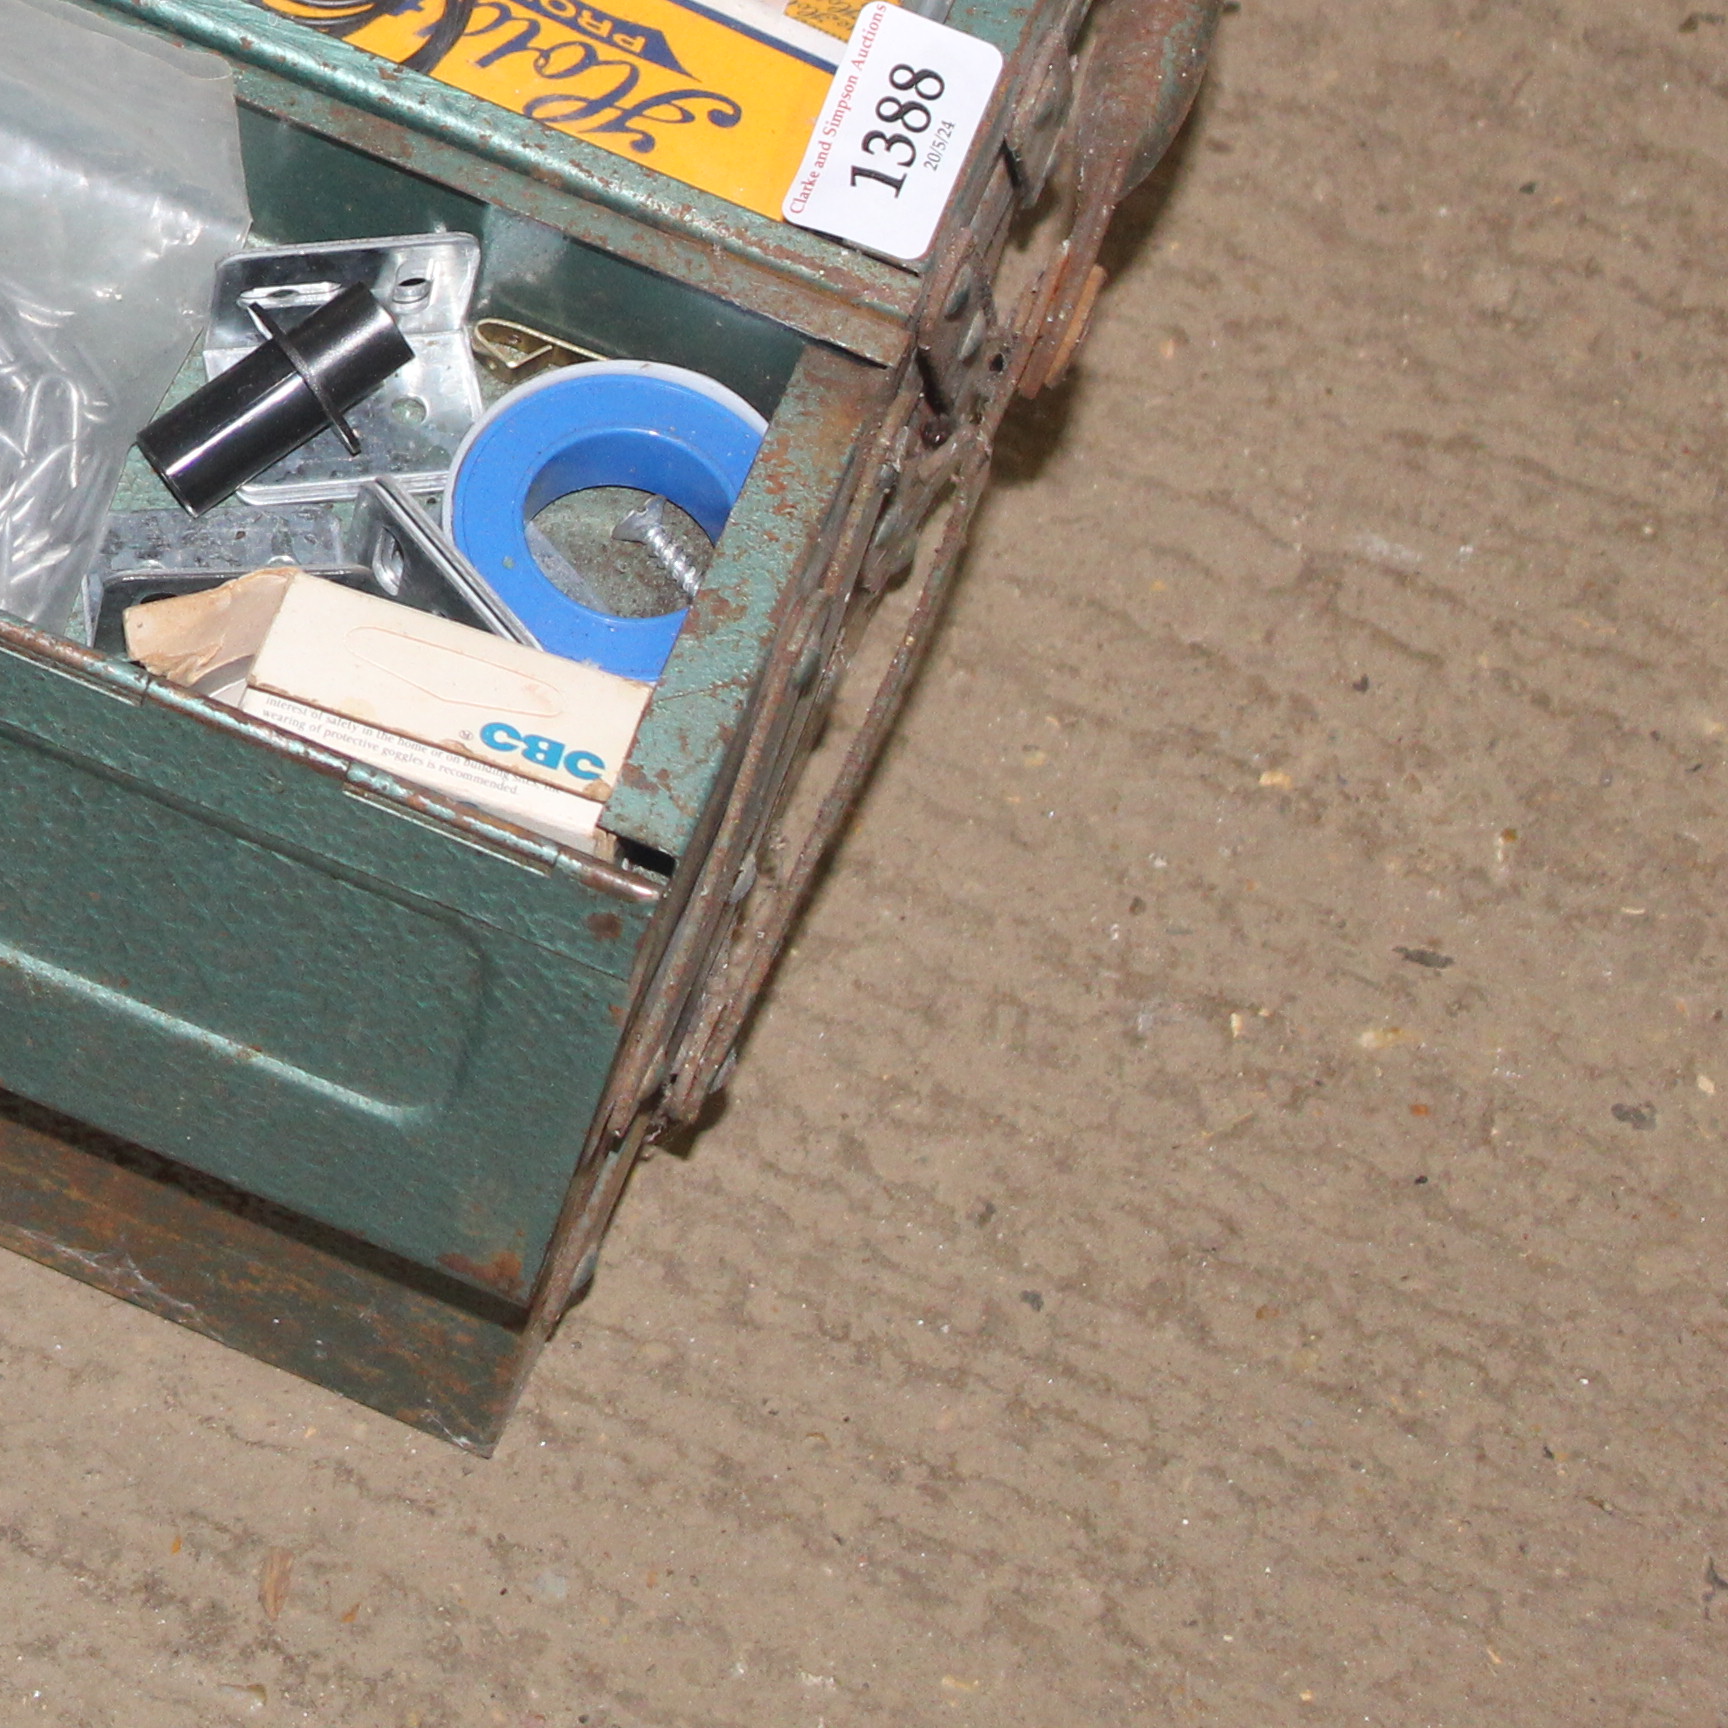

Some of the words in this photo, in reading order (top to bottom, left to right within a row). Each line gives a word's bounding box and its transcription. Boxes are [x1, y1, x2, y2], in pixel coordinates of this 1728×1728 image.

[789, 170, 820, 214] Clarke
[814, 141, 831, 169] and
[823, 73, 858, 138] Simpson
[851, 3, 887, 71] Auctions
[850, 63, 945, 199] 1388
[923, 120, 956, 172] 20/5/24
[262, 709, 306, 733] wearing
[309, 721, 322, 735] of
[323, 726, 379, 752] protective
[381, 744, 424, 768] goggles
[426, 757, 437, 770] is
